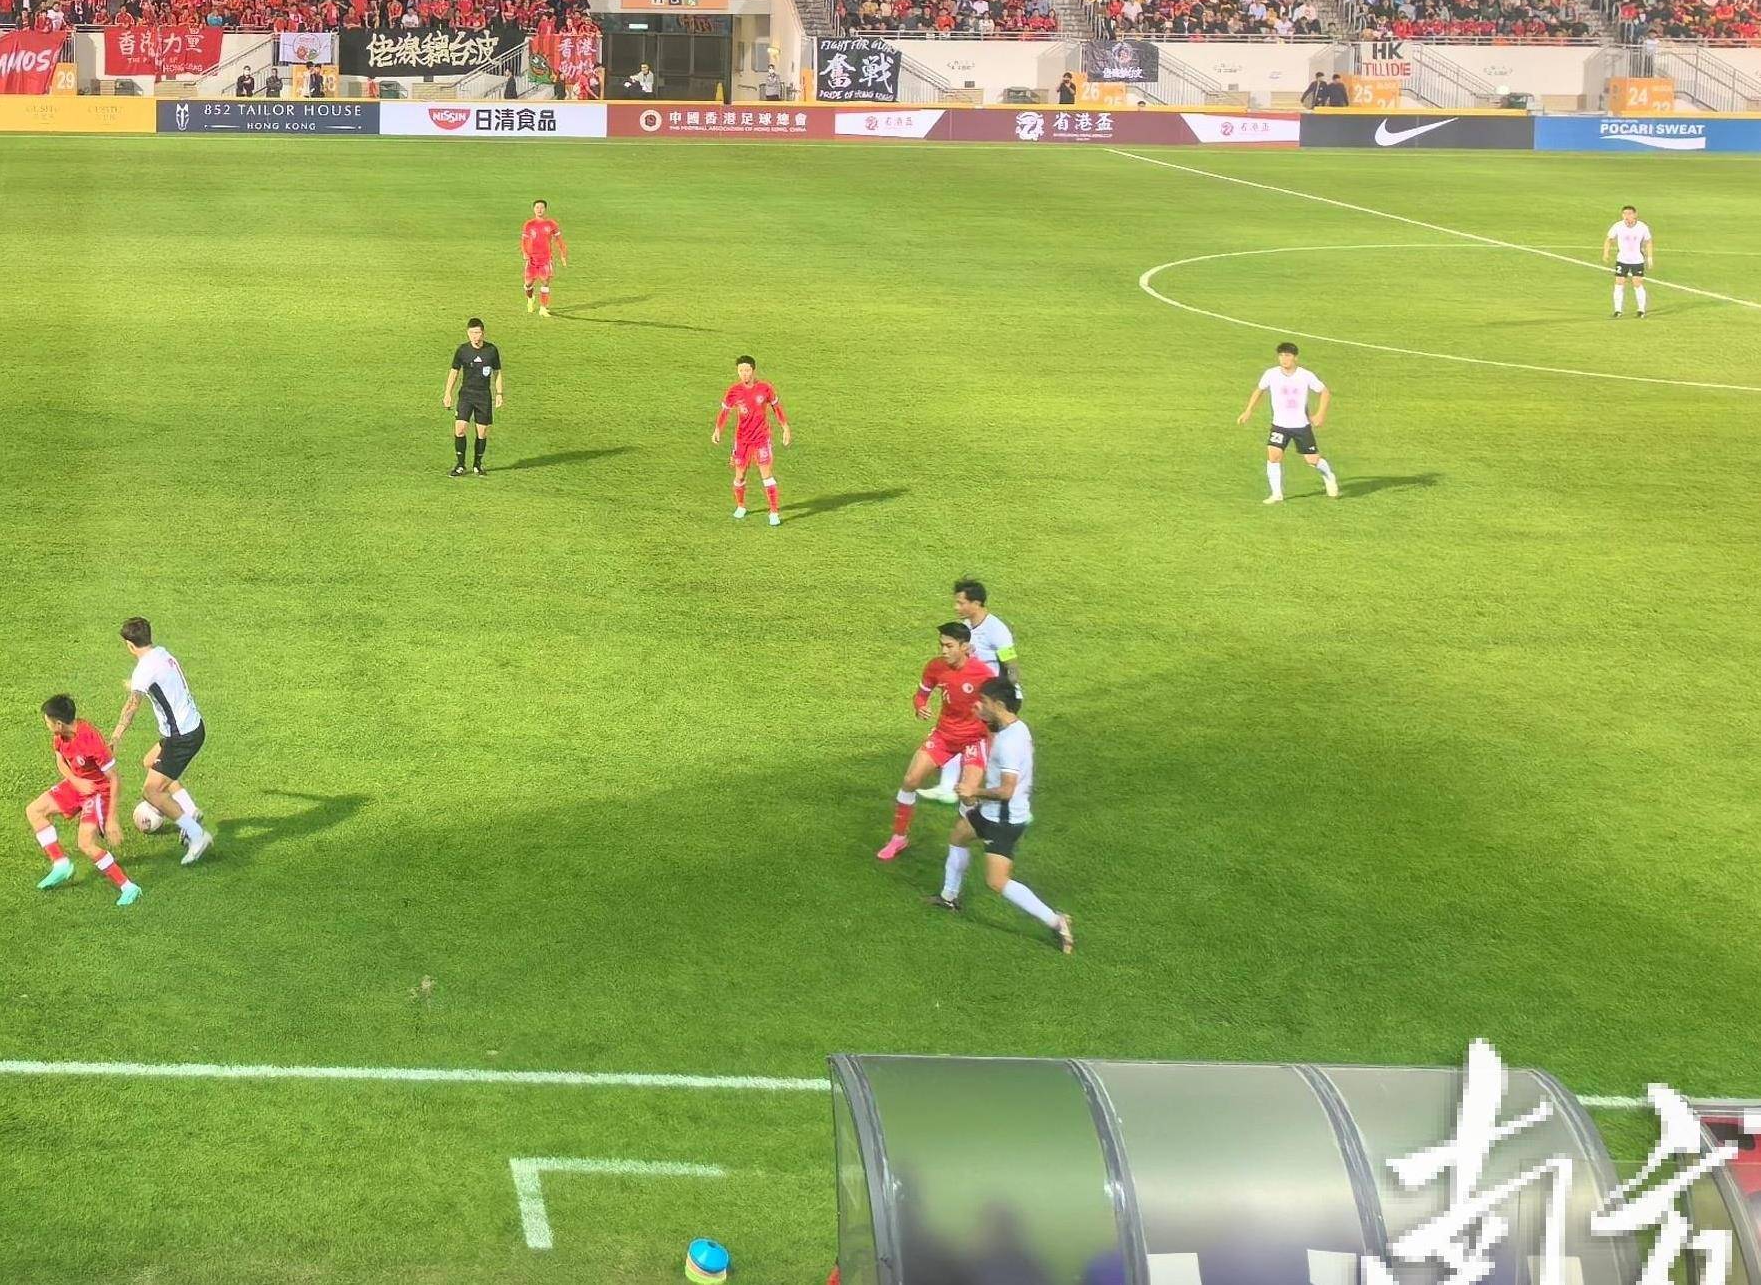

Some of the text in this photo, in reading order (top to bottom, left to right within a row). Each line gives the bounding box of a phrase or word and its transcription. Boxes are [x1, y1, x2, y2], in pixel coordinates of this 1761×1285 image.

[1372, 42, 1404, 60] HK
[57, 70, 75, 90] 29
[1354, 84, 1373, 104] 25
[1627, 86, 1648, 107] 24
[203, 104, 362, 116] 852 TAILOR HOUSE
[432, 110, 467, 123] NISSIN
[246, 122, 317, 131] HONG KONG
[475, 108, 557, 132] 日清食品
[669, 111, 807, 126] 中國香港足球總會
[1599, 123, 1706, 135] POCARI SWEAT
